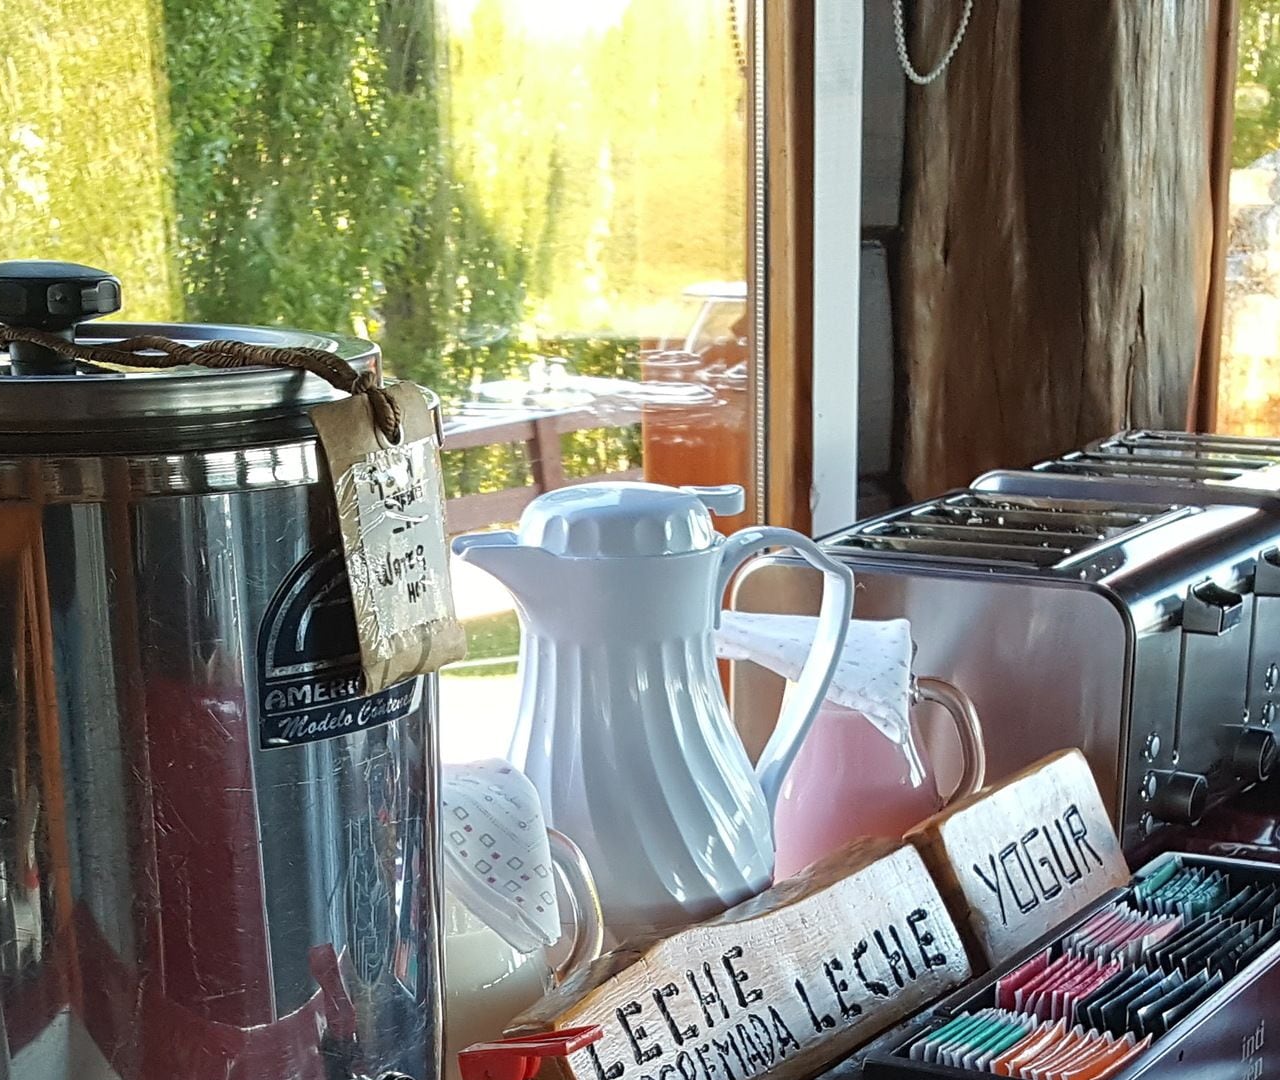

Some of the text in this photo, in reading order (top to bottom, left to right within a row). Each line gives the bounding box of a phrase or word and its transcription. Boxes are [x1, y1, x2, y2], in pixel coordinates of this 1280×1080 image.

[278, 707, 353, 738] Modelo
[973, 804, 1104, 926] YOGUR
[795, 908, 947, 1033] LECHE
[1241, 1019, 1265, 1063] inti
